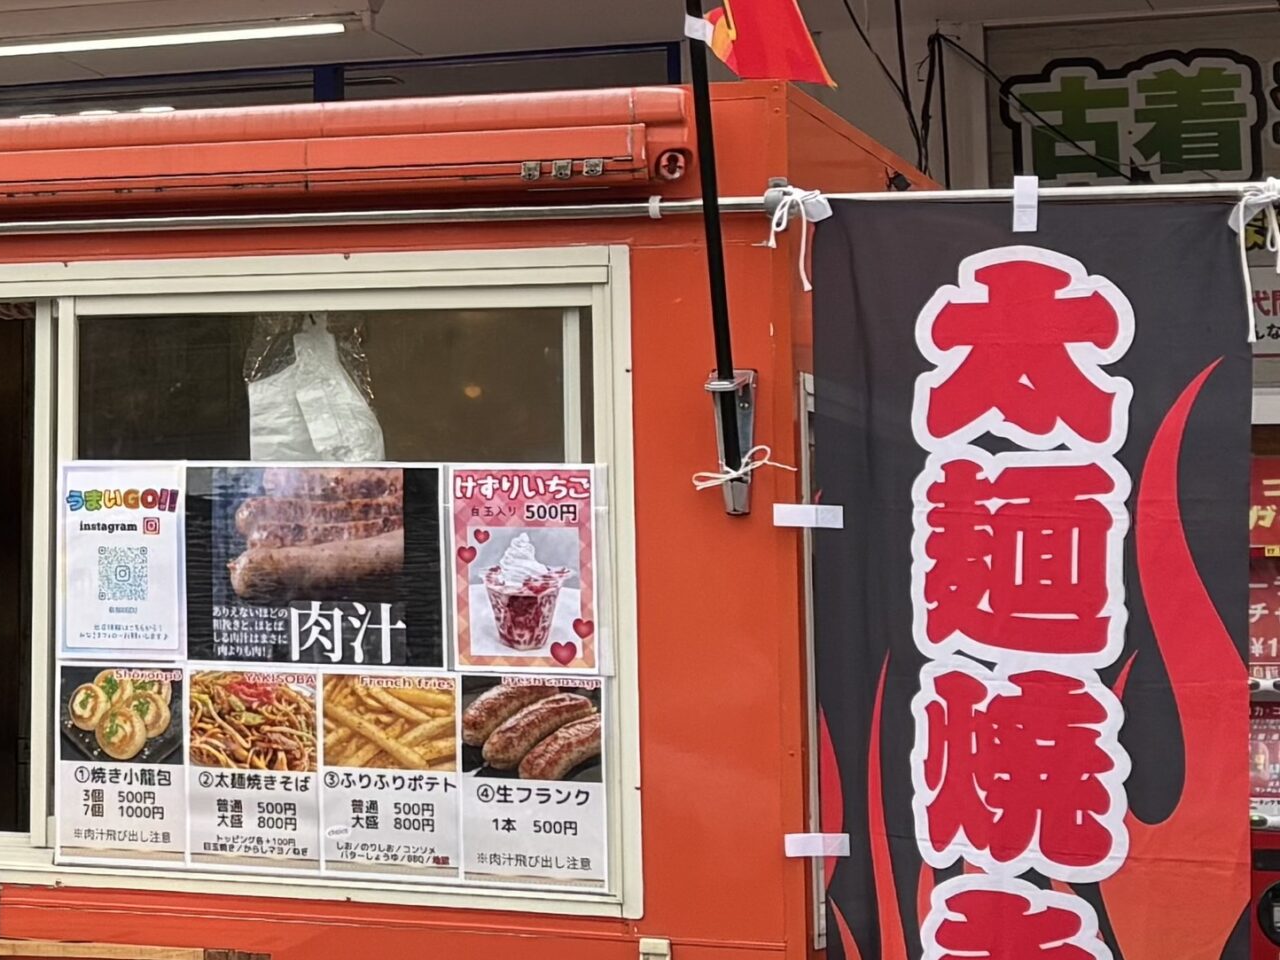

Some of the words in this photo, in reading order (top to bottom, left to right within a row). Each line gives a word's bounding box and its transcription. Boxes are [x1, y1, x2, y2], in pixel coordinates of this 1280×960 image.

[1017, 67, 1247, 183] 古着
[454, 474, 590, 499] けずりいちご
[524, 504, 577, 521] 500円
[80, 521, 137, 533] instagram
[290, 600, 408, 664] 肉汁
[244, 672, 316, 685] YAKISOBA
[360, 676, 413, 688] French
[83, 789, 104, 802] 3個
[118, 791, 156, 805] 500円
[83, 804, 104, 817] 7個
[118, 806, 164, 820] 1000円
[217, 799, 243, 813] 普通
[257, 802, 297, 816] 500円
[351, 799, 379, 814] 普通
[393, 802, 434, 817] 500円
[217, 814, 243, 828] 大盛
[257, 817, 297, 831] 800円
[351, 815, 379, 829] 大盛
[393, 818, 435, 832] 800円
[492, 817, 517, 833] 1本
[533, 820, 578, 836] 500円
